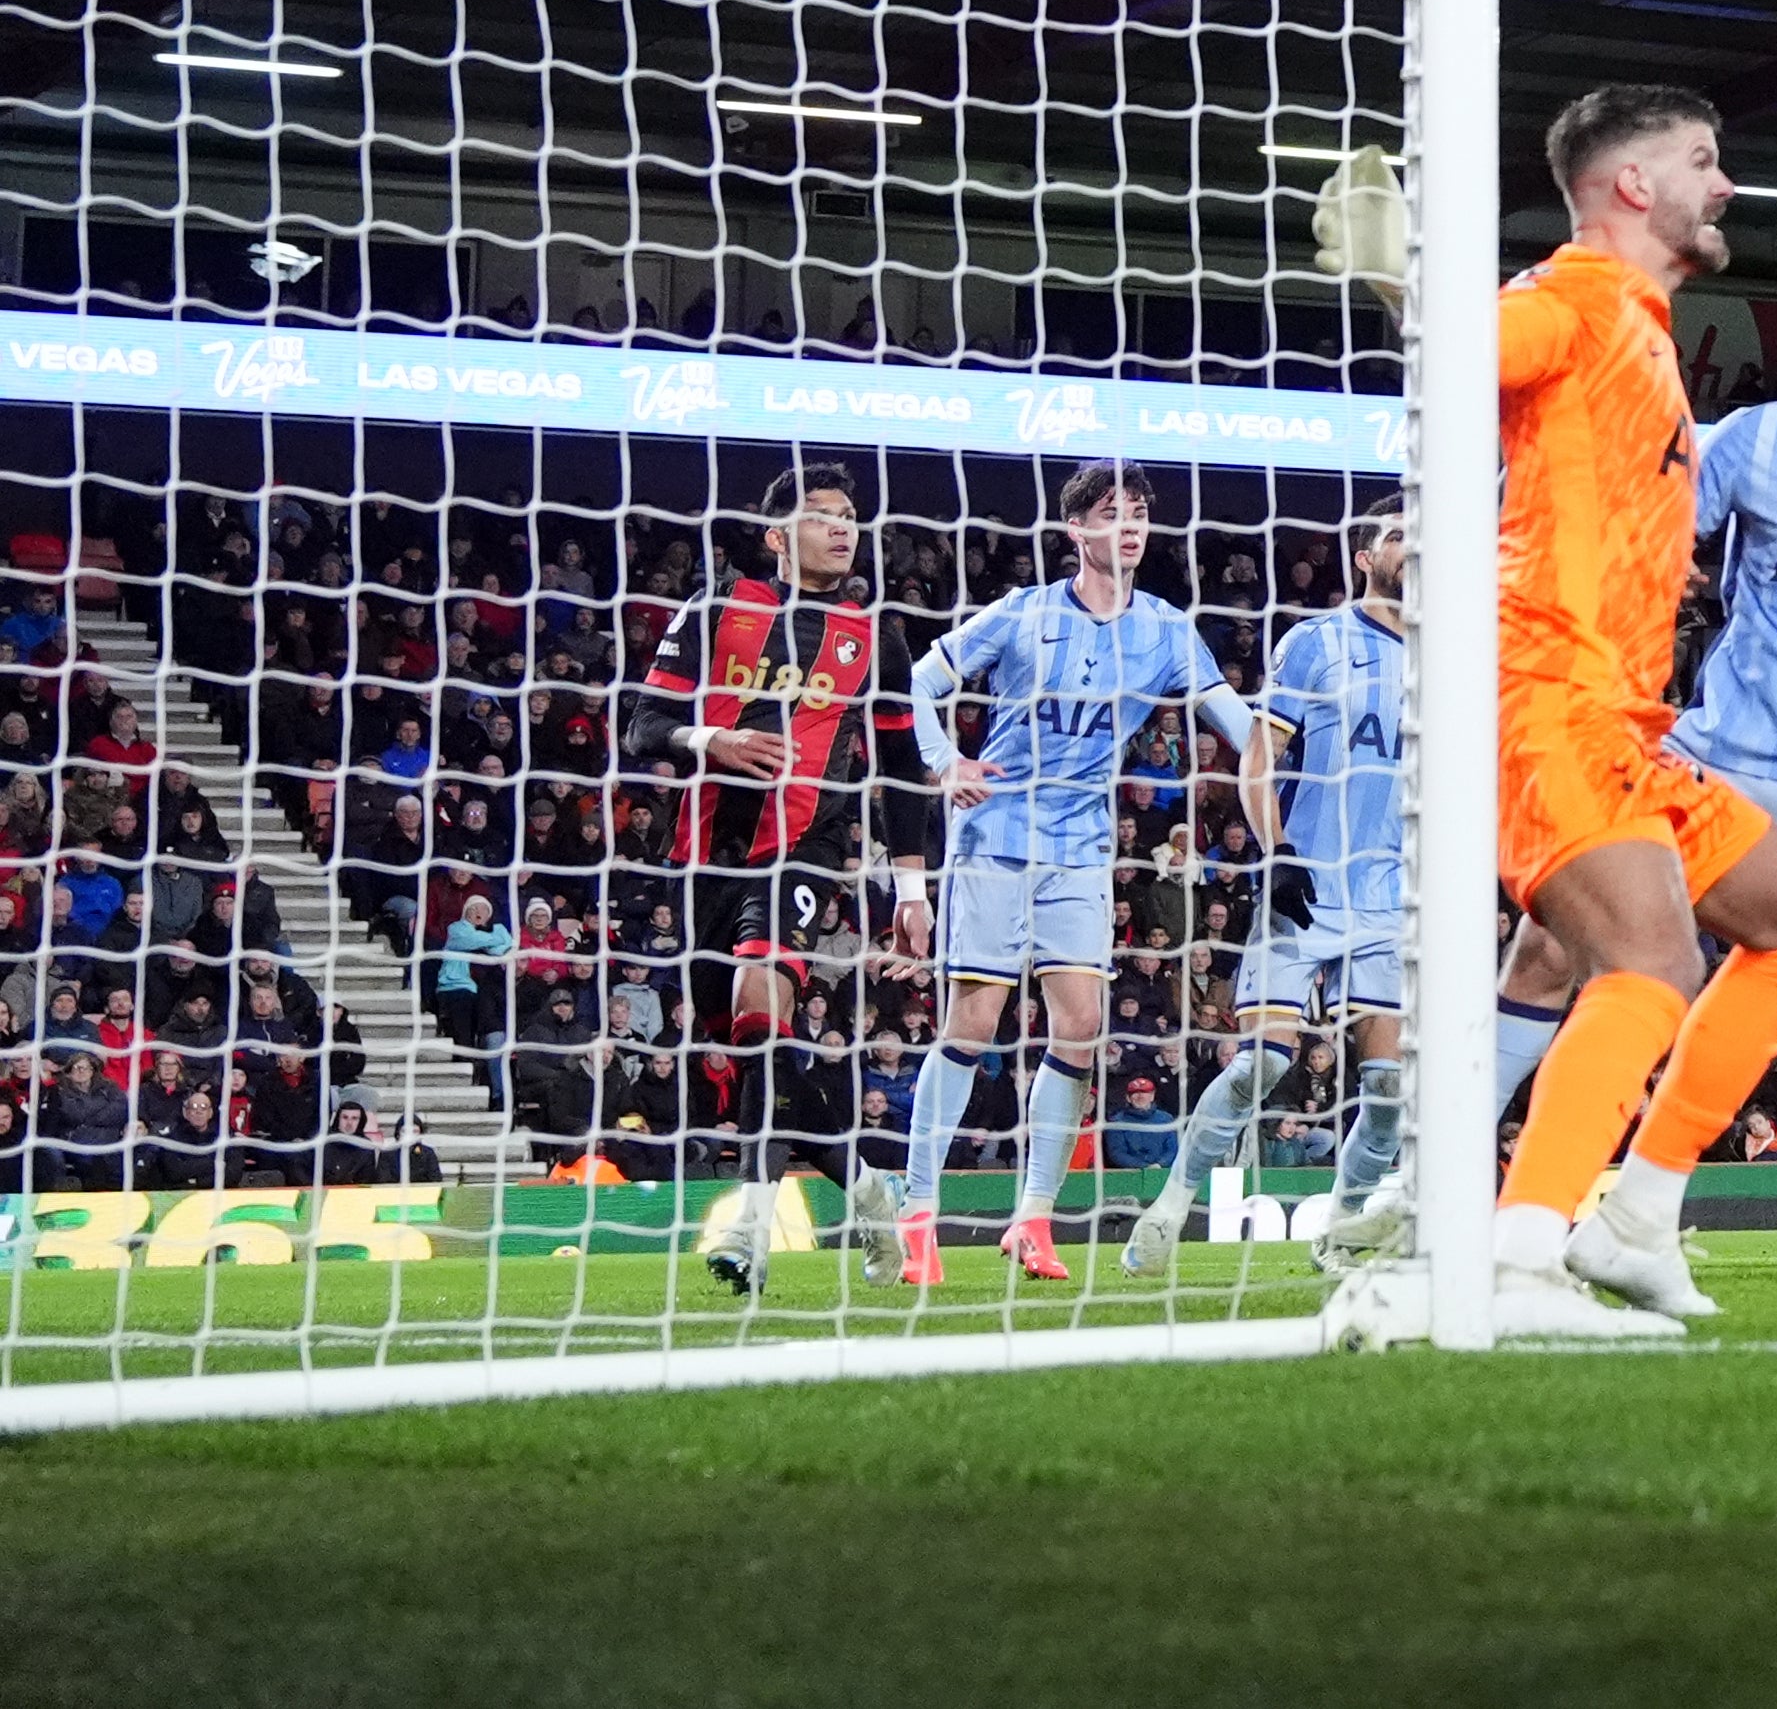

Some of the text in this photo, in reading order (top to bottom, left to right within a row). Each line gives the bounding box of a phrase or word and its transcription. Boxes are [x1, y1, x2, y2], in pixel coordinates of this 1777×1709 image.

[11, 342, 158, 376] VEGAS
[358, 363, 582, 399] LAS VEGAS
[764, 386, 972, 422] LAS VEGAS
[1140, 408, 1208, 435] LAS
[1216, 412, 1331, 441] VEGAS
[794, 884, 817, 928] 9
